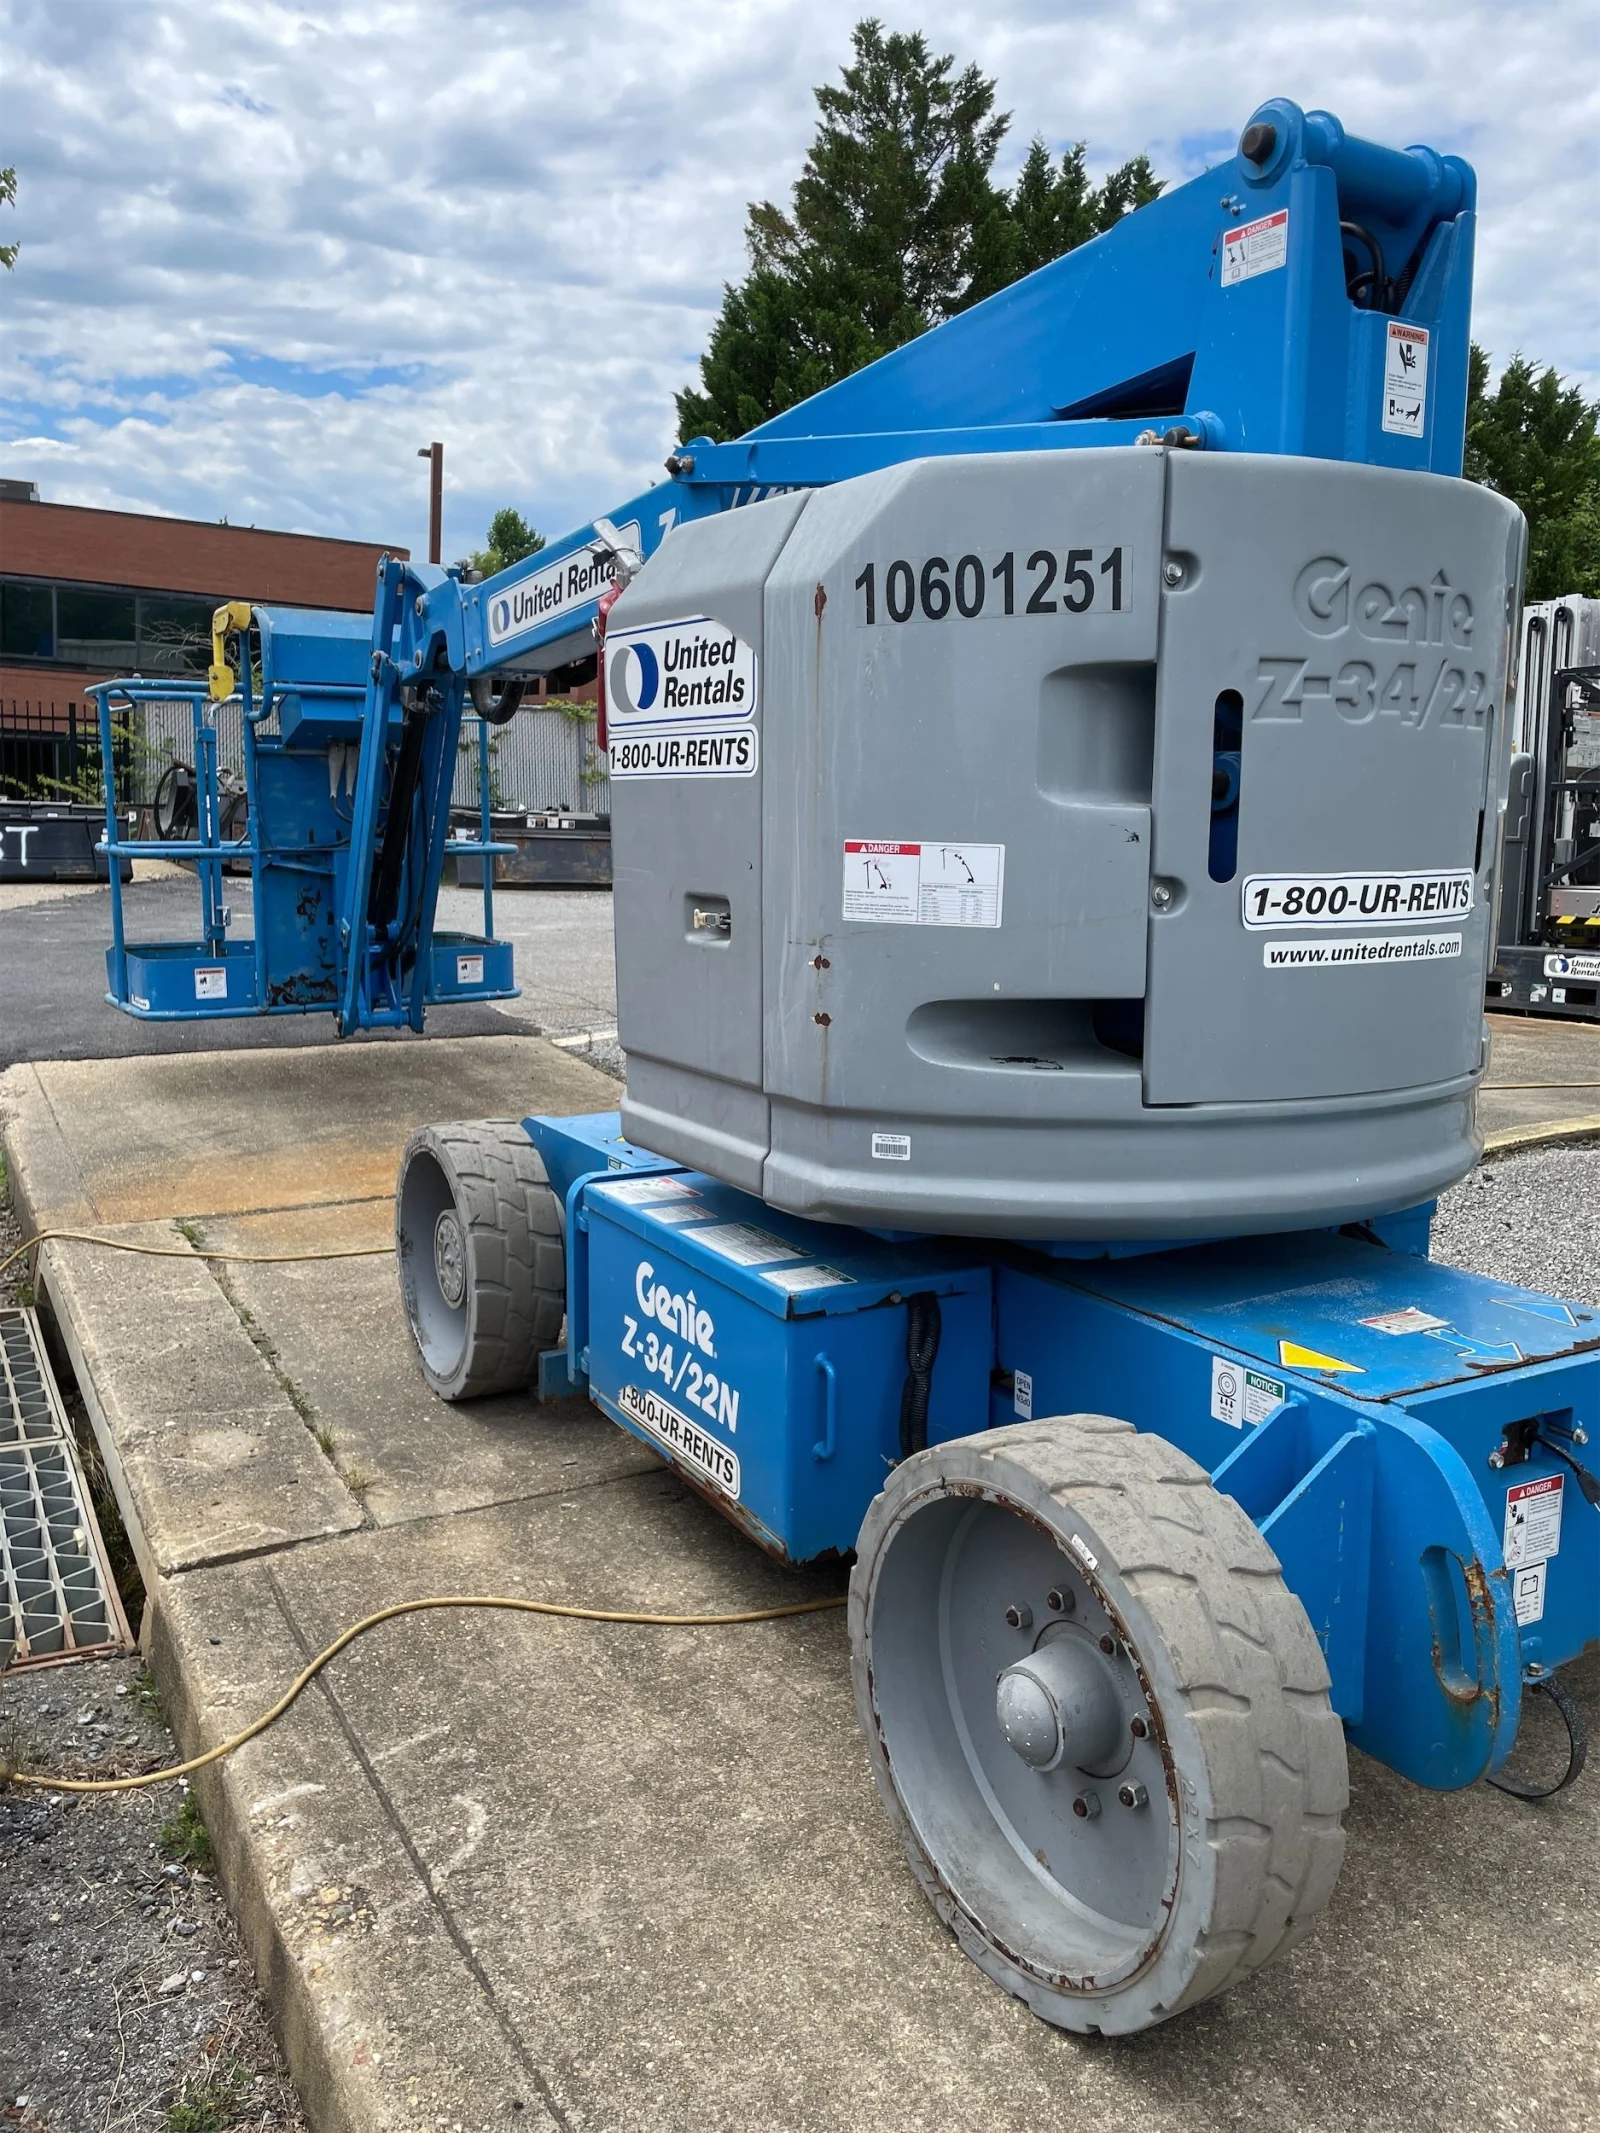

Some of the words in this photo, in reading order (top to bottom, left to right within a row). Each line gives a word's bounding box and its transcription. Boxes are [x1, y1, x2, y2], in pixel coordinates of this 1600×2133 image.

[1247, 219, 1273, 236] DANGER
[1396, 330, 1425, 342] WARNING
[513, 571, 563, 624] United
[567, 563, 616, 599] Renta
[855, 547, 1122, 625] 10601251
[1293, 555, 1475, 650] Genie
[664, 635, 737, 672] United
[663, 669, 745, 708] Rentals
[610, 736, 750, 770] 1-800-UR-RENTS
[867, 843, 900, 854] DANGER
[1254, 879, 1469, 916] 1-800-UR-RENTS
[1270, 938, 1461, 964] www.unitedrentals.com
[635, 1261, 716, 1354] Genie
[621, 1315, 740, 1434] Z-34/22N
[1250, 1375, 1278, 1395] NOTICE
[622, 1386, 734, 1484] 1-800-UR-RENTS
[1526, 1481, 1552, 1496] DANGER
